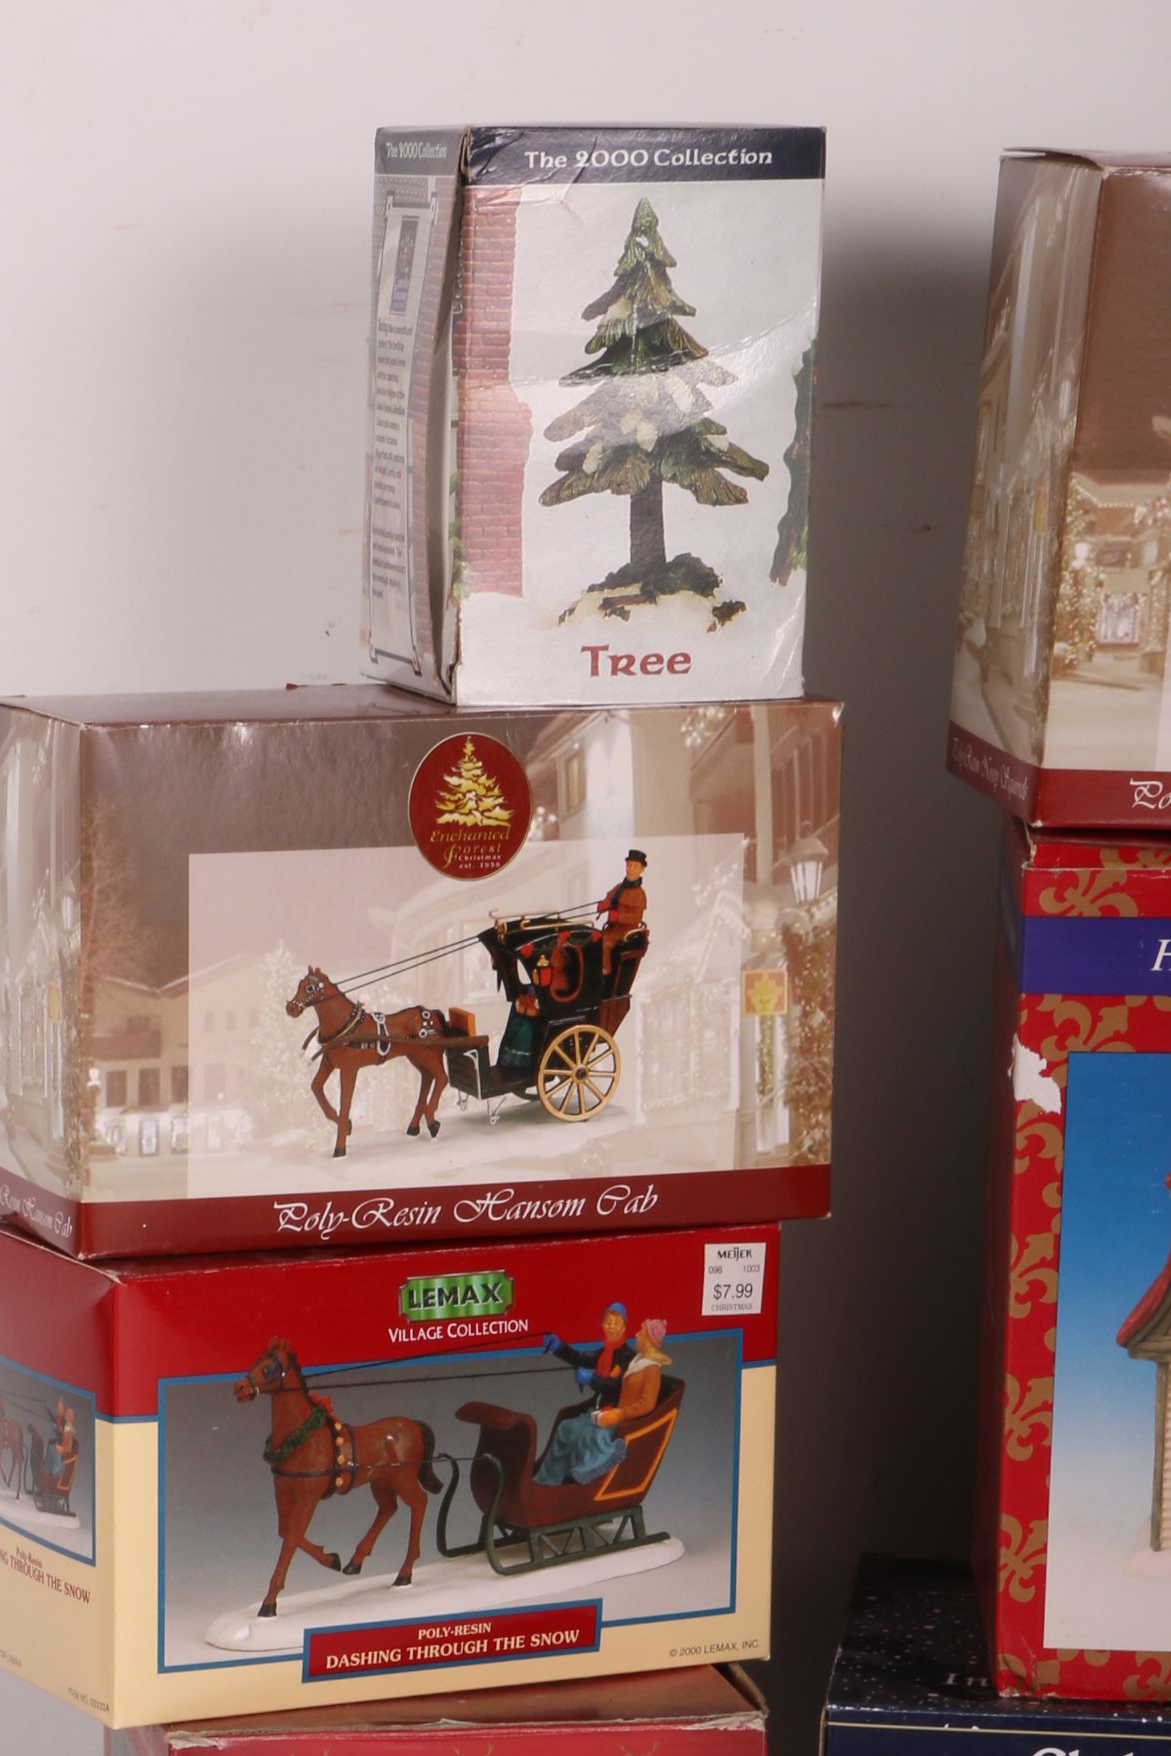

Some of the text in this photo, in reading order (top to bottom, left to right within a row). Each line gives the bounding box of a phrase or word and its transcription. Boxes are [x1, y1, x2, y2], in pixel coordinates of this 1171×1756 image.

[525, 147, 773, 168] The 2000 Collection
[580, 643, 692, 677] Tree
[430, 829, 510, 843] Enchanted
[443, 842, 501, 870] Forest
[274, 1184, 659, 1240] Poly-Resin Hansom Cab
[408, 1282, 503, 1311] LEMAX
[713, 1282, 754, 1301] $7.99
[10, 1554, 45, 1585] THROUGH
[46, 1573, 62, 1593] THE
[64, 1581, 91, 1604] SNOW
[418, 1622, 492, 1640] POLY-RESIN
[326, 1629, 580, 1669] DASHING THROUGH THE SNOW
